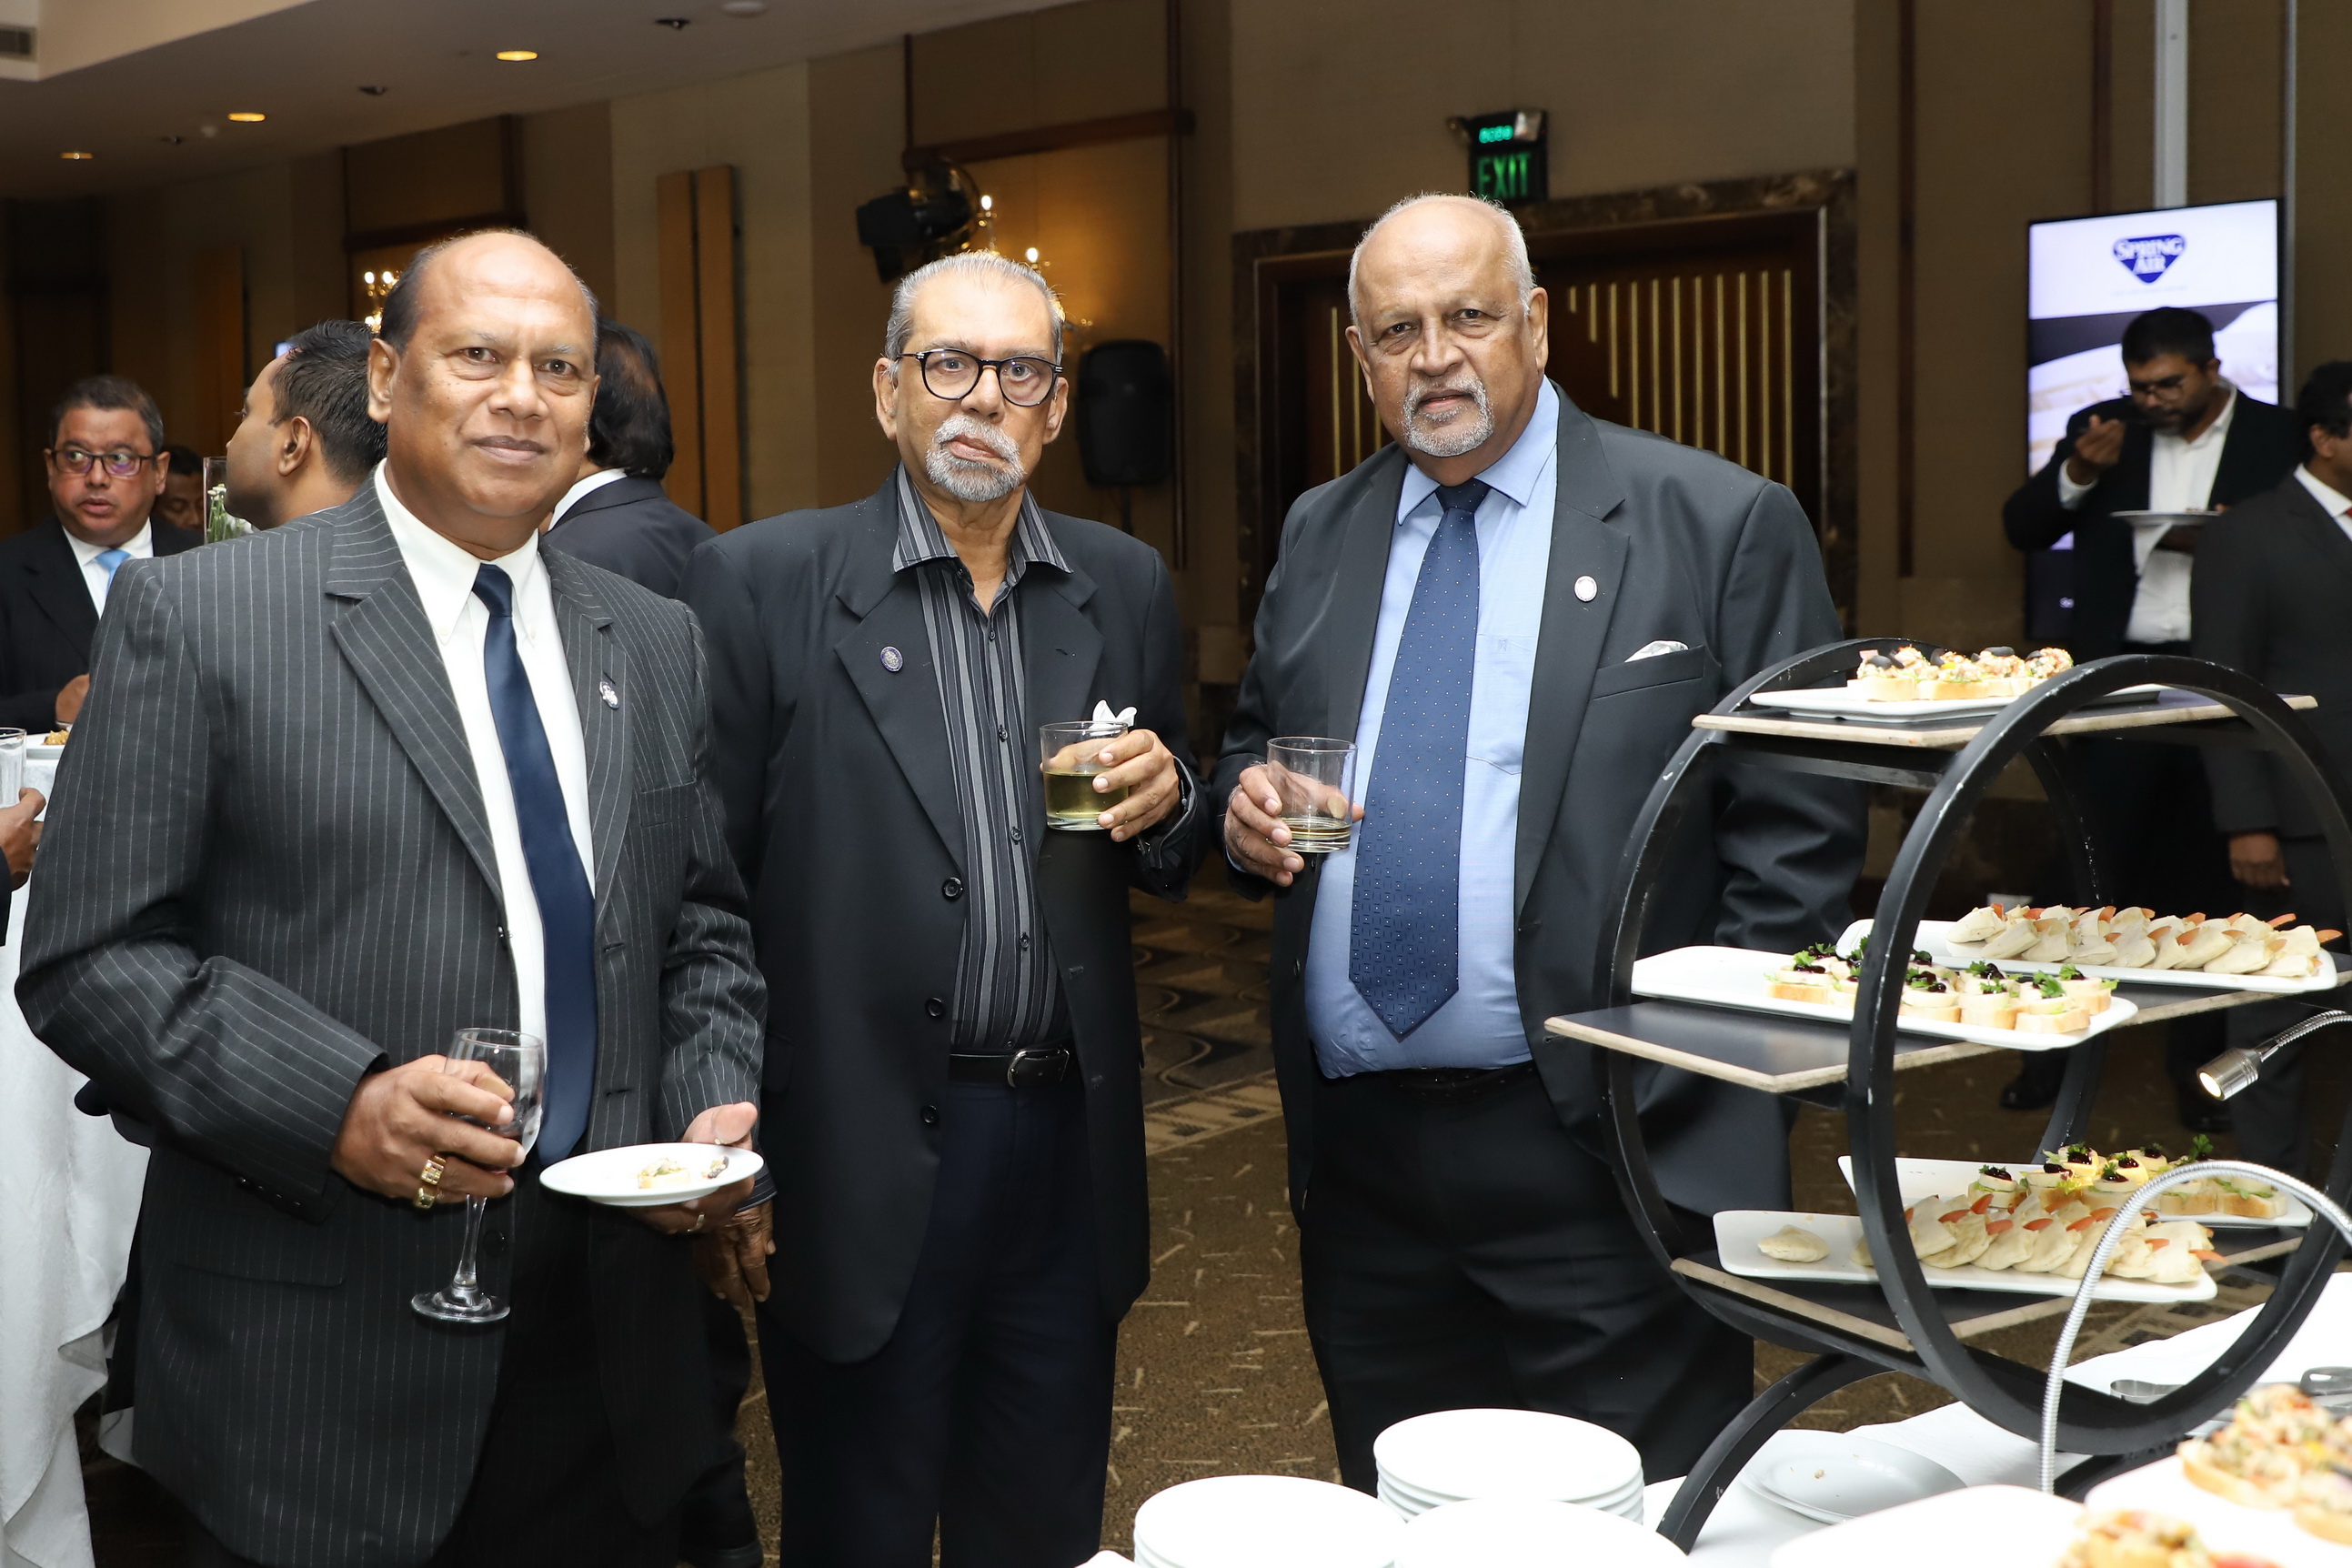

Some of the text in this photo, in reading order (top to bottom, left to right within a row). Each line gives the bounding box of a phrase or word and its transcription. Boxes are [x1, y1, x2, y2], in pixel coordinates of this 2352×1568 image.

[1477, 153, 1531, 198] EXIT
[2113, 237, 2185, 259] SPRING
[2133, 256, 2166, 274] AIR
